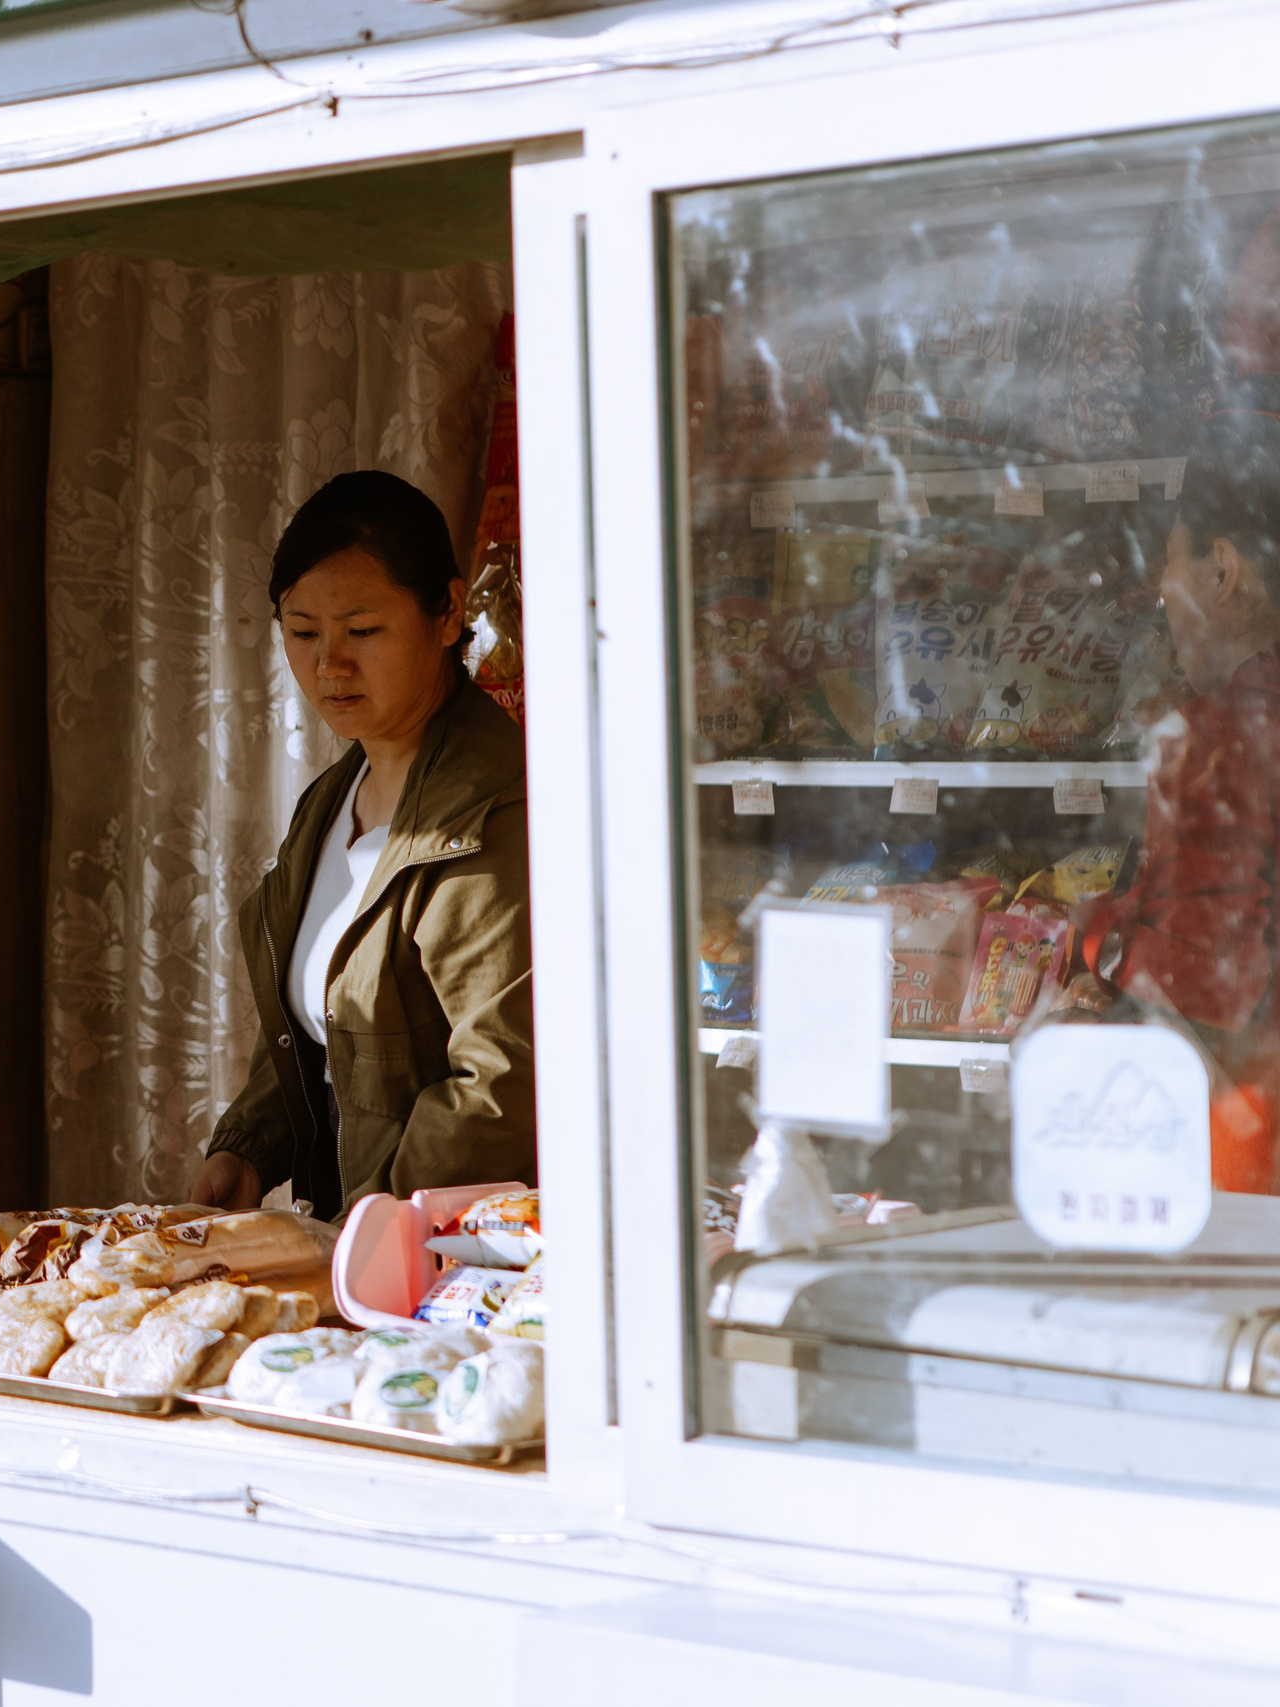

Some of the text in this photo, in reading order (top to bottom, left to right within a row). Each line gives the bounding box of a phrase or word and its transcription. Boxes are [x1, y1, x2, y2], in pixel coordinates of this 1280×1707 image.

[885, 626, 996, 662] 우유사
[827, 866, 887, 883] 새우맛
[892, 960, 931, 990] 우맛
